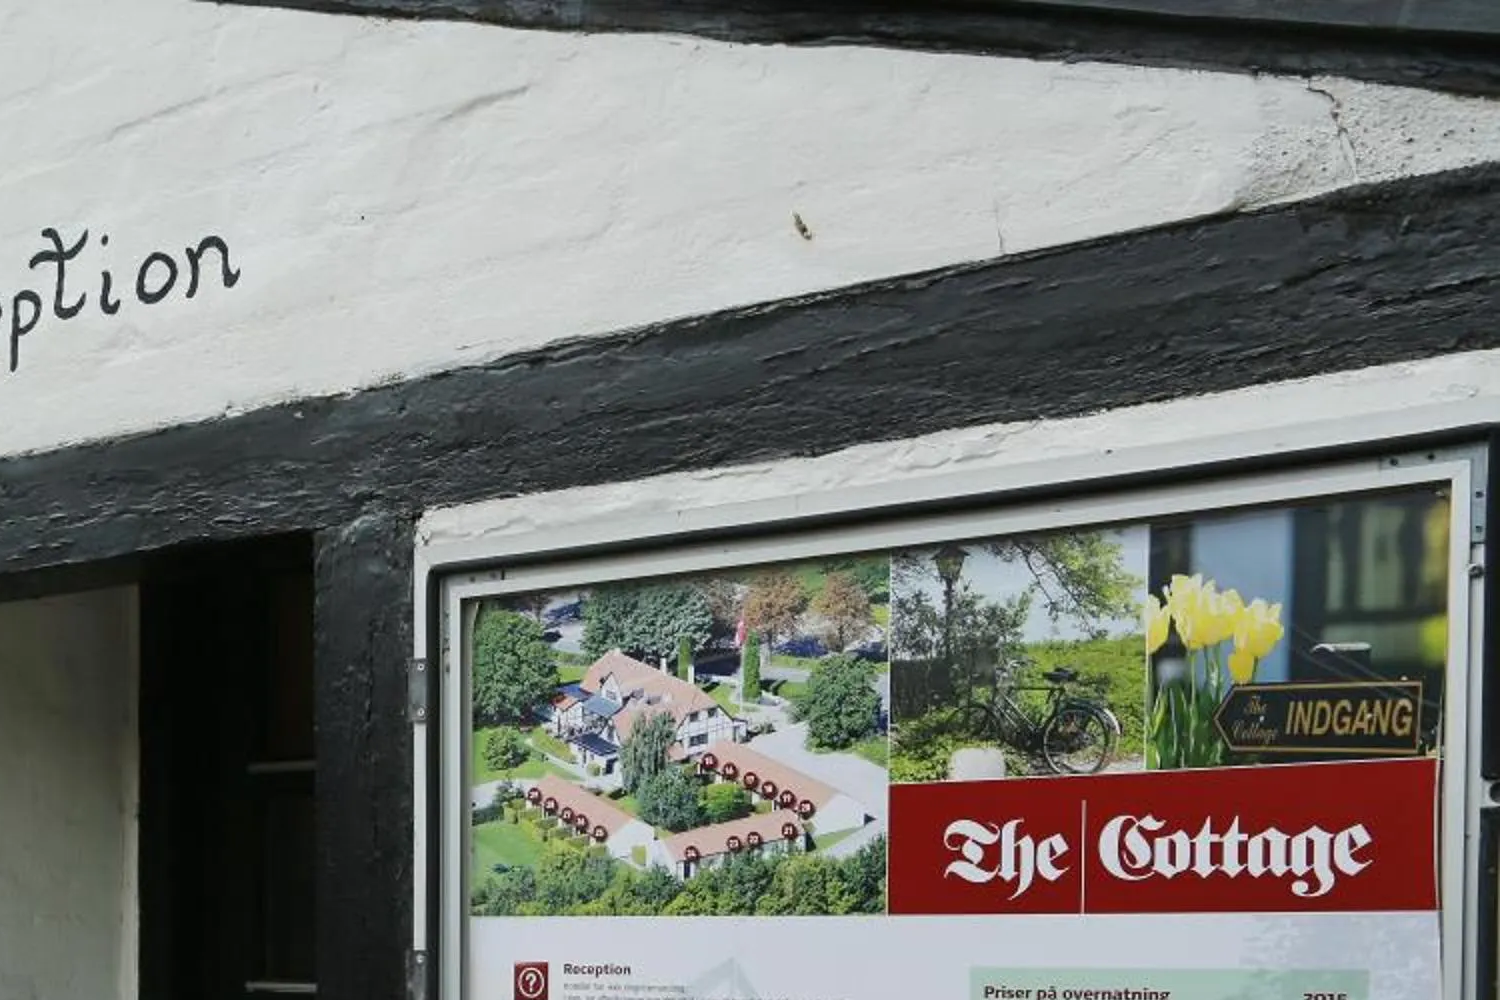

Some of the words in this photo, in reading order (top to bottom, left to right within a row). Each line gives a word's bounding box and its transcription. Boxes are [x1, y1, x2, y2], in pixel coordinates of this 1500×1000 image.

[1285, 699, 1414, 737] INDGANG
[943, 817, 1070, 900] The
[1099, 815, 1374, 897] Cottage
[563, 963, 633, 979] Reception
[984, 985, 1033, 1000] Priser
